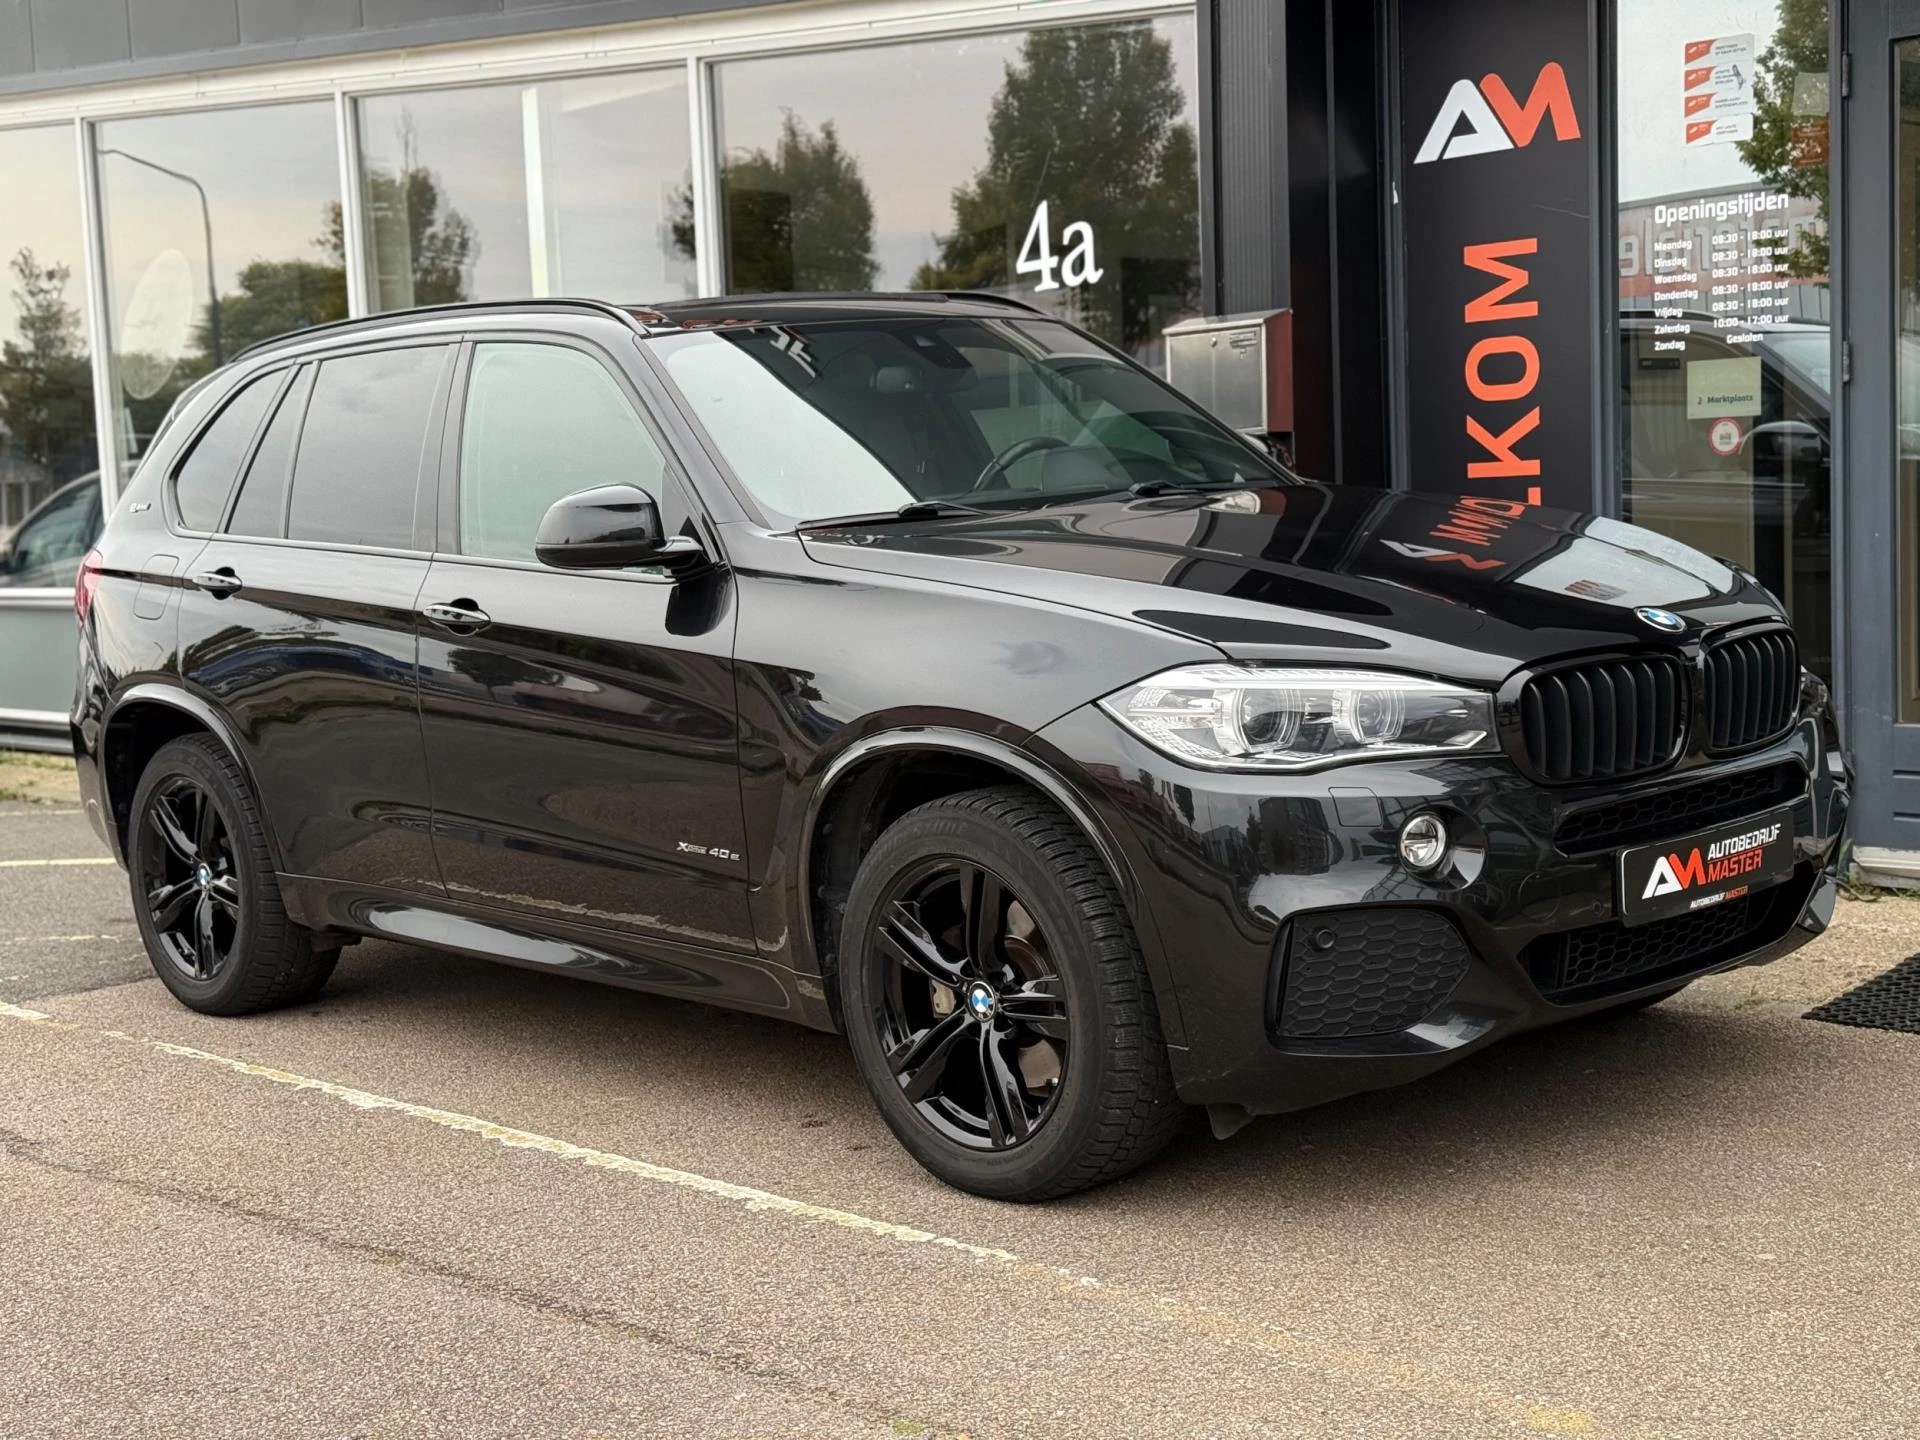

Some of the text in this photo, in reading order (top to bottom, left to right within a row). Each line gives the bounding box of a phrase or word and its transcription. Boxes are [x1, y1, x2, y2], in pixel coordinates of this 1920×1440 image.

[1413, 62, 1581, 164] AM
[1655, 192, 1789, 227] Openingstijden
[1016, 200, 1104, 292] 4a
[1654, 240, 1692, 251] Maandag
[1774, 229, 1789, 237] uur
[1654, 257, 1687, 268] Dinsdag
[1774, 246, 1789, 254] uur
[1654, 272, 1697, 284] Woensdag
[1774, 263, 1789, 272] uur
[1654, 289, 1699, 301] Donderdag
[1774, 280, 1789, 289] uur
[1654, 307, 1683, 318] Vrijdag
[1774, 297, 1789, 306] uur
[1654, 324, 1690, 335] Zaterdag
[1774, 314, 1789, 323] uur
[1654, 340, 1685, 351] Zondag
[1708, 824, 1782, 860] AUTOBEDRIJF
[1642, 848, 1706, 900] AM
[1708, 850, 1763, 883] MASTER
